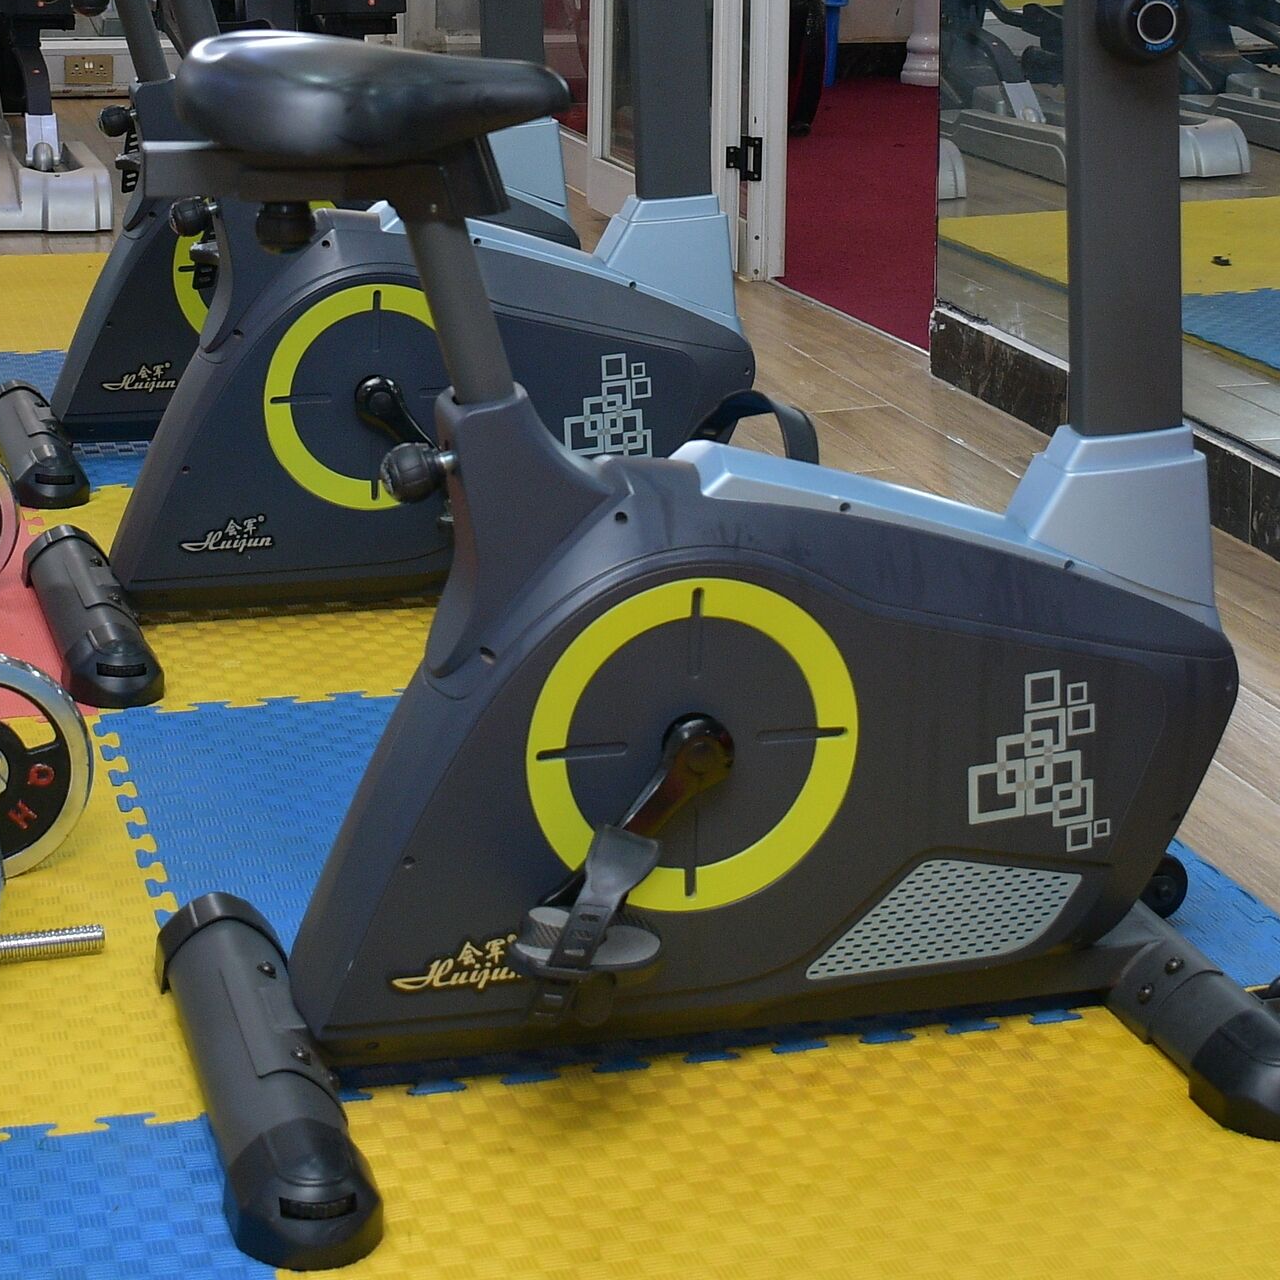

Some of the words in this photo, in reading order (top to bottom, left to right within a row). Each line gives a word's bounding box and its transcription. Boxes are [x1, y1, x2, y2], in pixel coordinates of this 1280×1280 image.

[102, 373, 177, 393] Huijun
[181, 530, 273, 552] Huijun
[392, 958, 522, 990] Huiju
